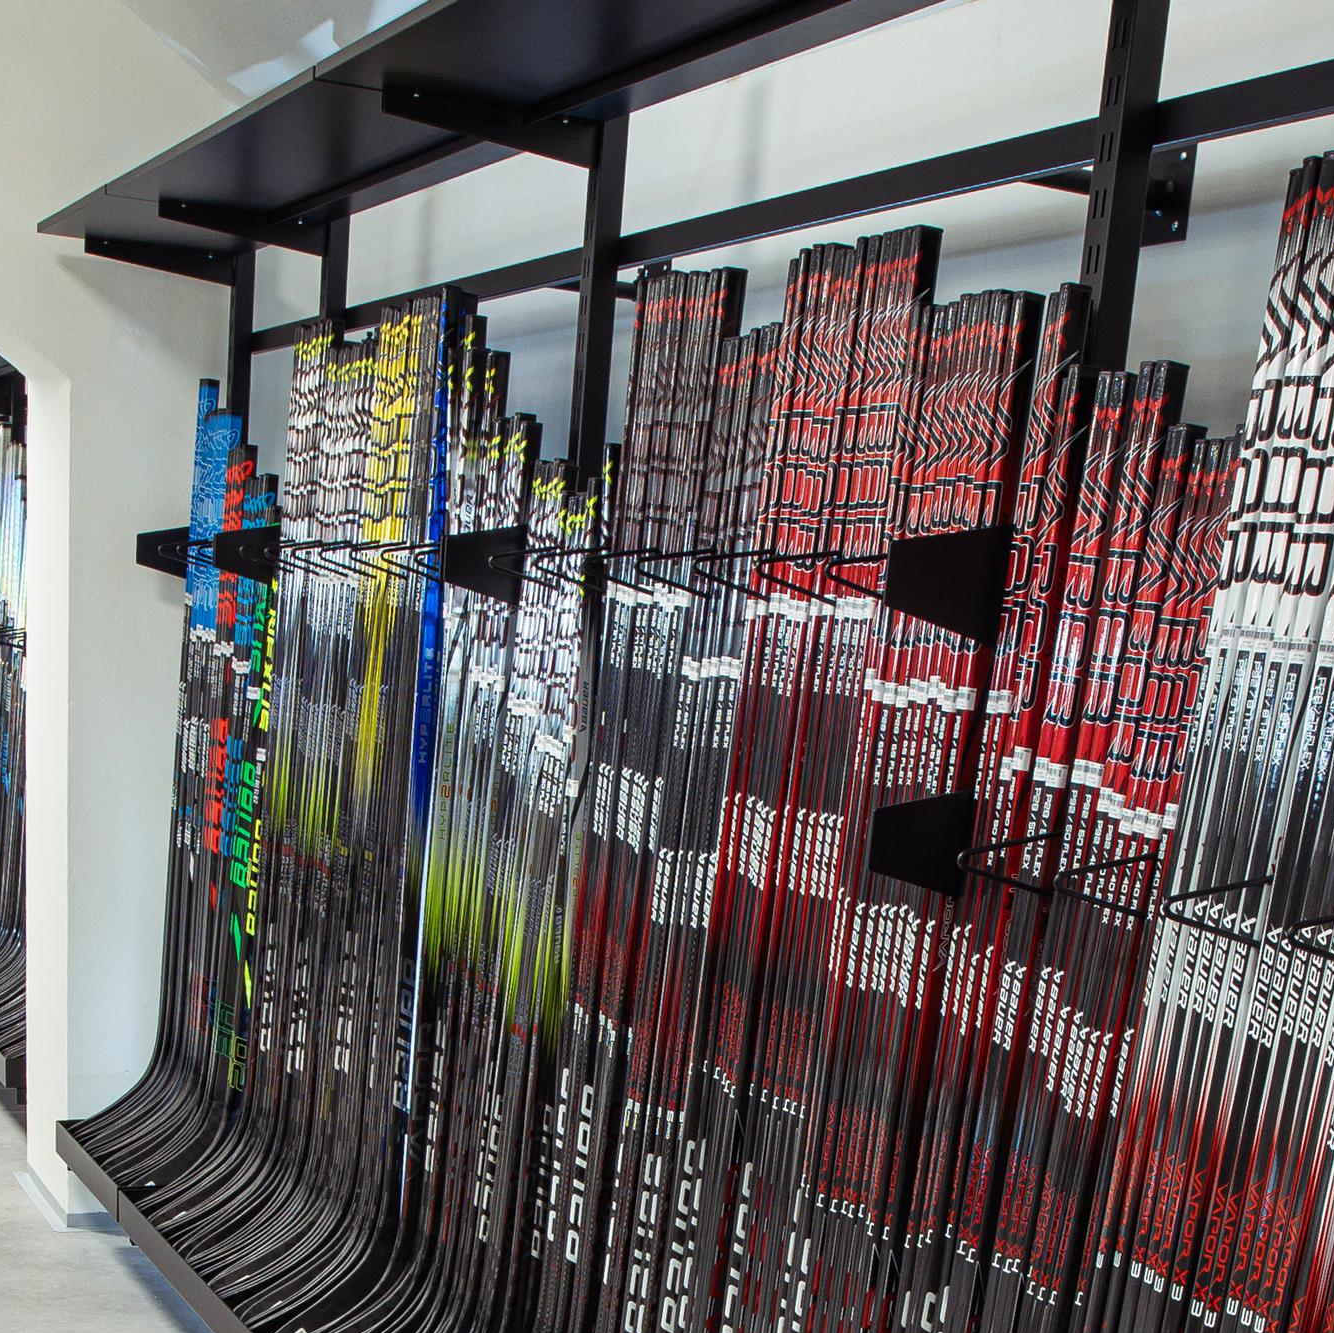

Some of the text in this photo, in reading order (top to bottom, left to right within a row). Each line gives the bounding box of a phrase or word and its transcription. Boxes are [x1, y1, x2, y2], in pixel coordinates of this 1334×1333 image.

[993, 973, 1011, 1044] BAUER
[1003, 979, 1021, 1051] BAUER
[1029, 980, 1046, 1052] BAUER
[1248, 944, 1275, 1040] BAUER
[1046, 1019, 1065, 1092] BAUER
[1110, 1042, 1129, 1118] BAUER
